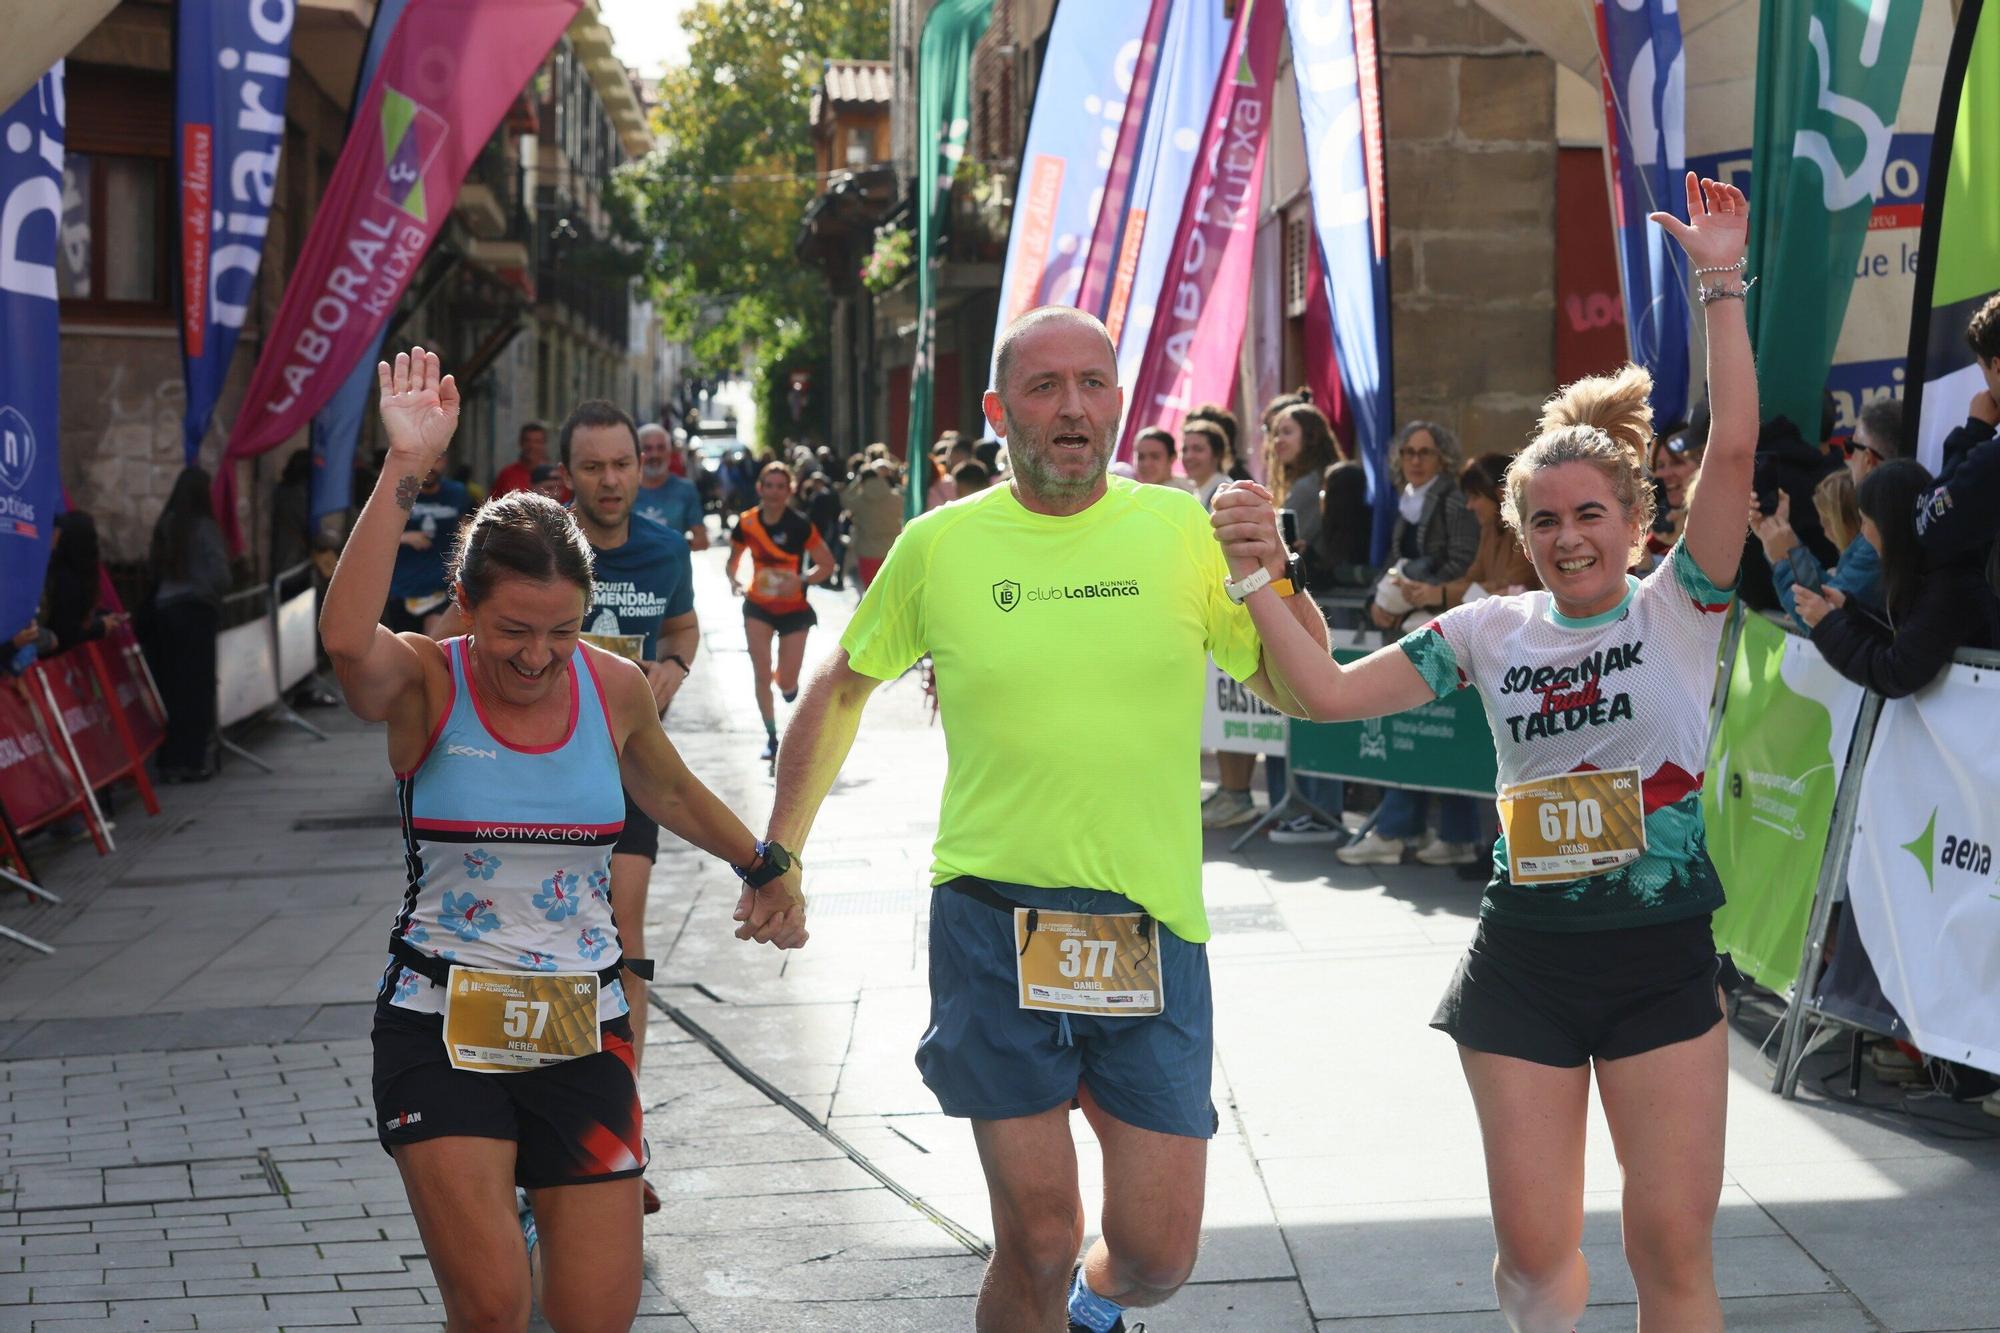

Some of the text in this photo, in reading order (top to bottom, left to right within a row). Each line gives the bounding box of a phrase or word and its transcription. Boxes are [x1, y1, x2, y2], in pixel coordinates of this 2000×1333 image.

[1216, 97, 1263, 232] kutxa
[361, 224, 428, 318] kutxa
[266, 213, 398, 415] LABORAL
[592, 581, 636, 593] QUISTA
[1026, 584, 1140, 602] club LaBlanca
[1099, 579, 1138, 588] RUNNING
[1505, 691, 1633, 744] TALDEA
[475, 826, 599, 842] MOTIVACIÓN
[1538, 798, 1603, 842] 670
[1558, 843, 1590, 855] ITXASO
[1940, 834, 1992, 876] aena
[1058, 938, 1117, 978] 377
[1073, 981, 1105, 991] DANIEL
[503, 999, 550, 1040] 57
[508, 1040, 539, 1052] NEREA
